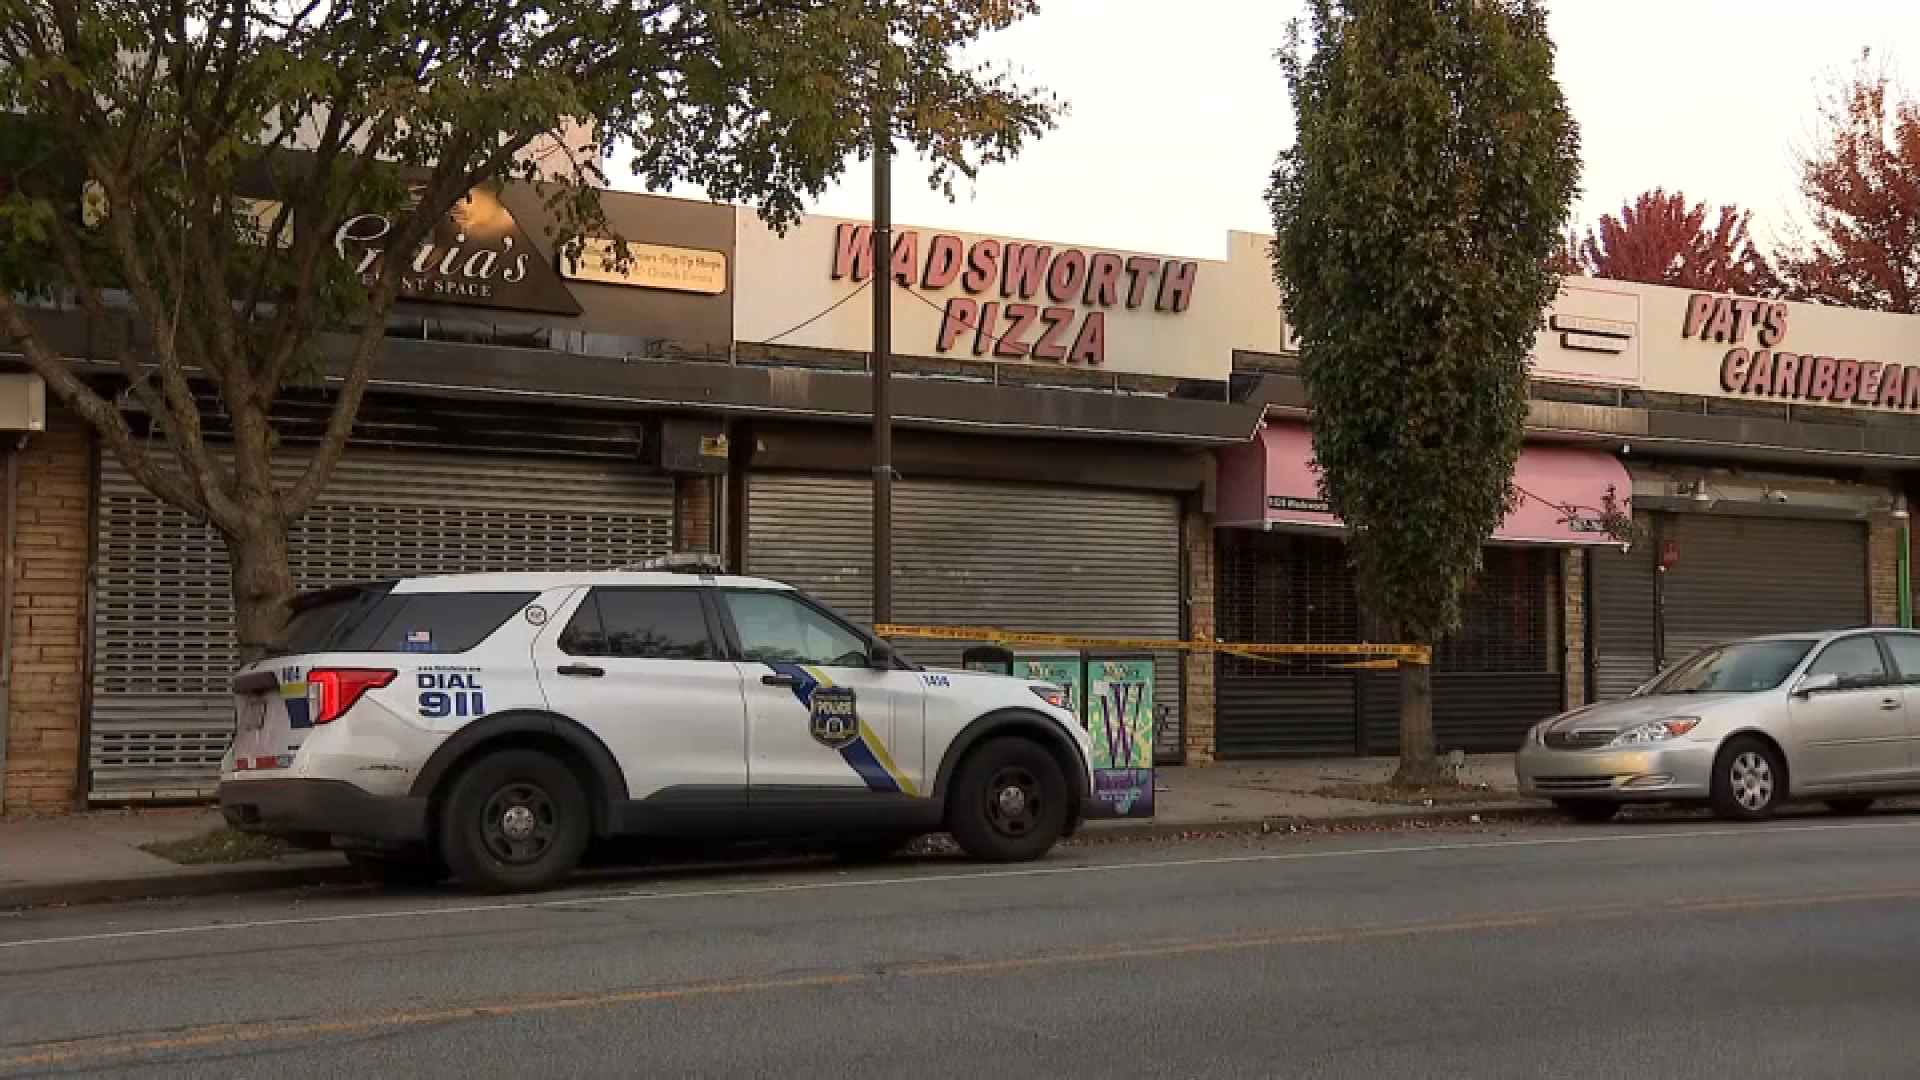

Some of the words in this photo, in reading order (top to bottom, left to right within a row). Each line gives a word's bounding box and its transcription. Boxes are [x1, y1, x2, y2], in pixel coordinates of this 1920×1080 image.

[434, 278, 492, 298] SPACE
[831, 223, 1198, 313] WADSWORTH
[935, 297, 1105, 365] PIZZA
[1682, 293, 1788, 349] PAT'S
[417, 673, 483, 689] DIAL
[418, 691, 485, 718] 911
